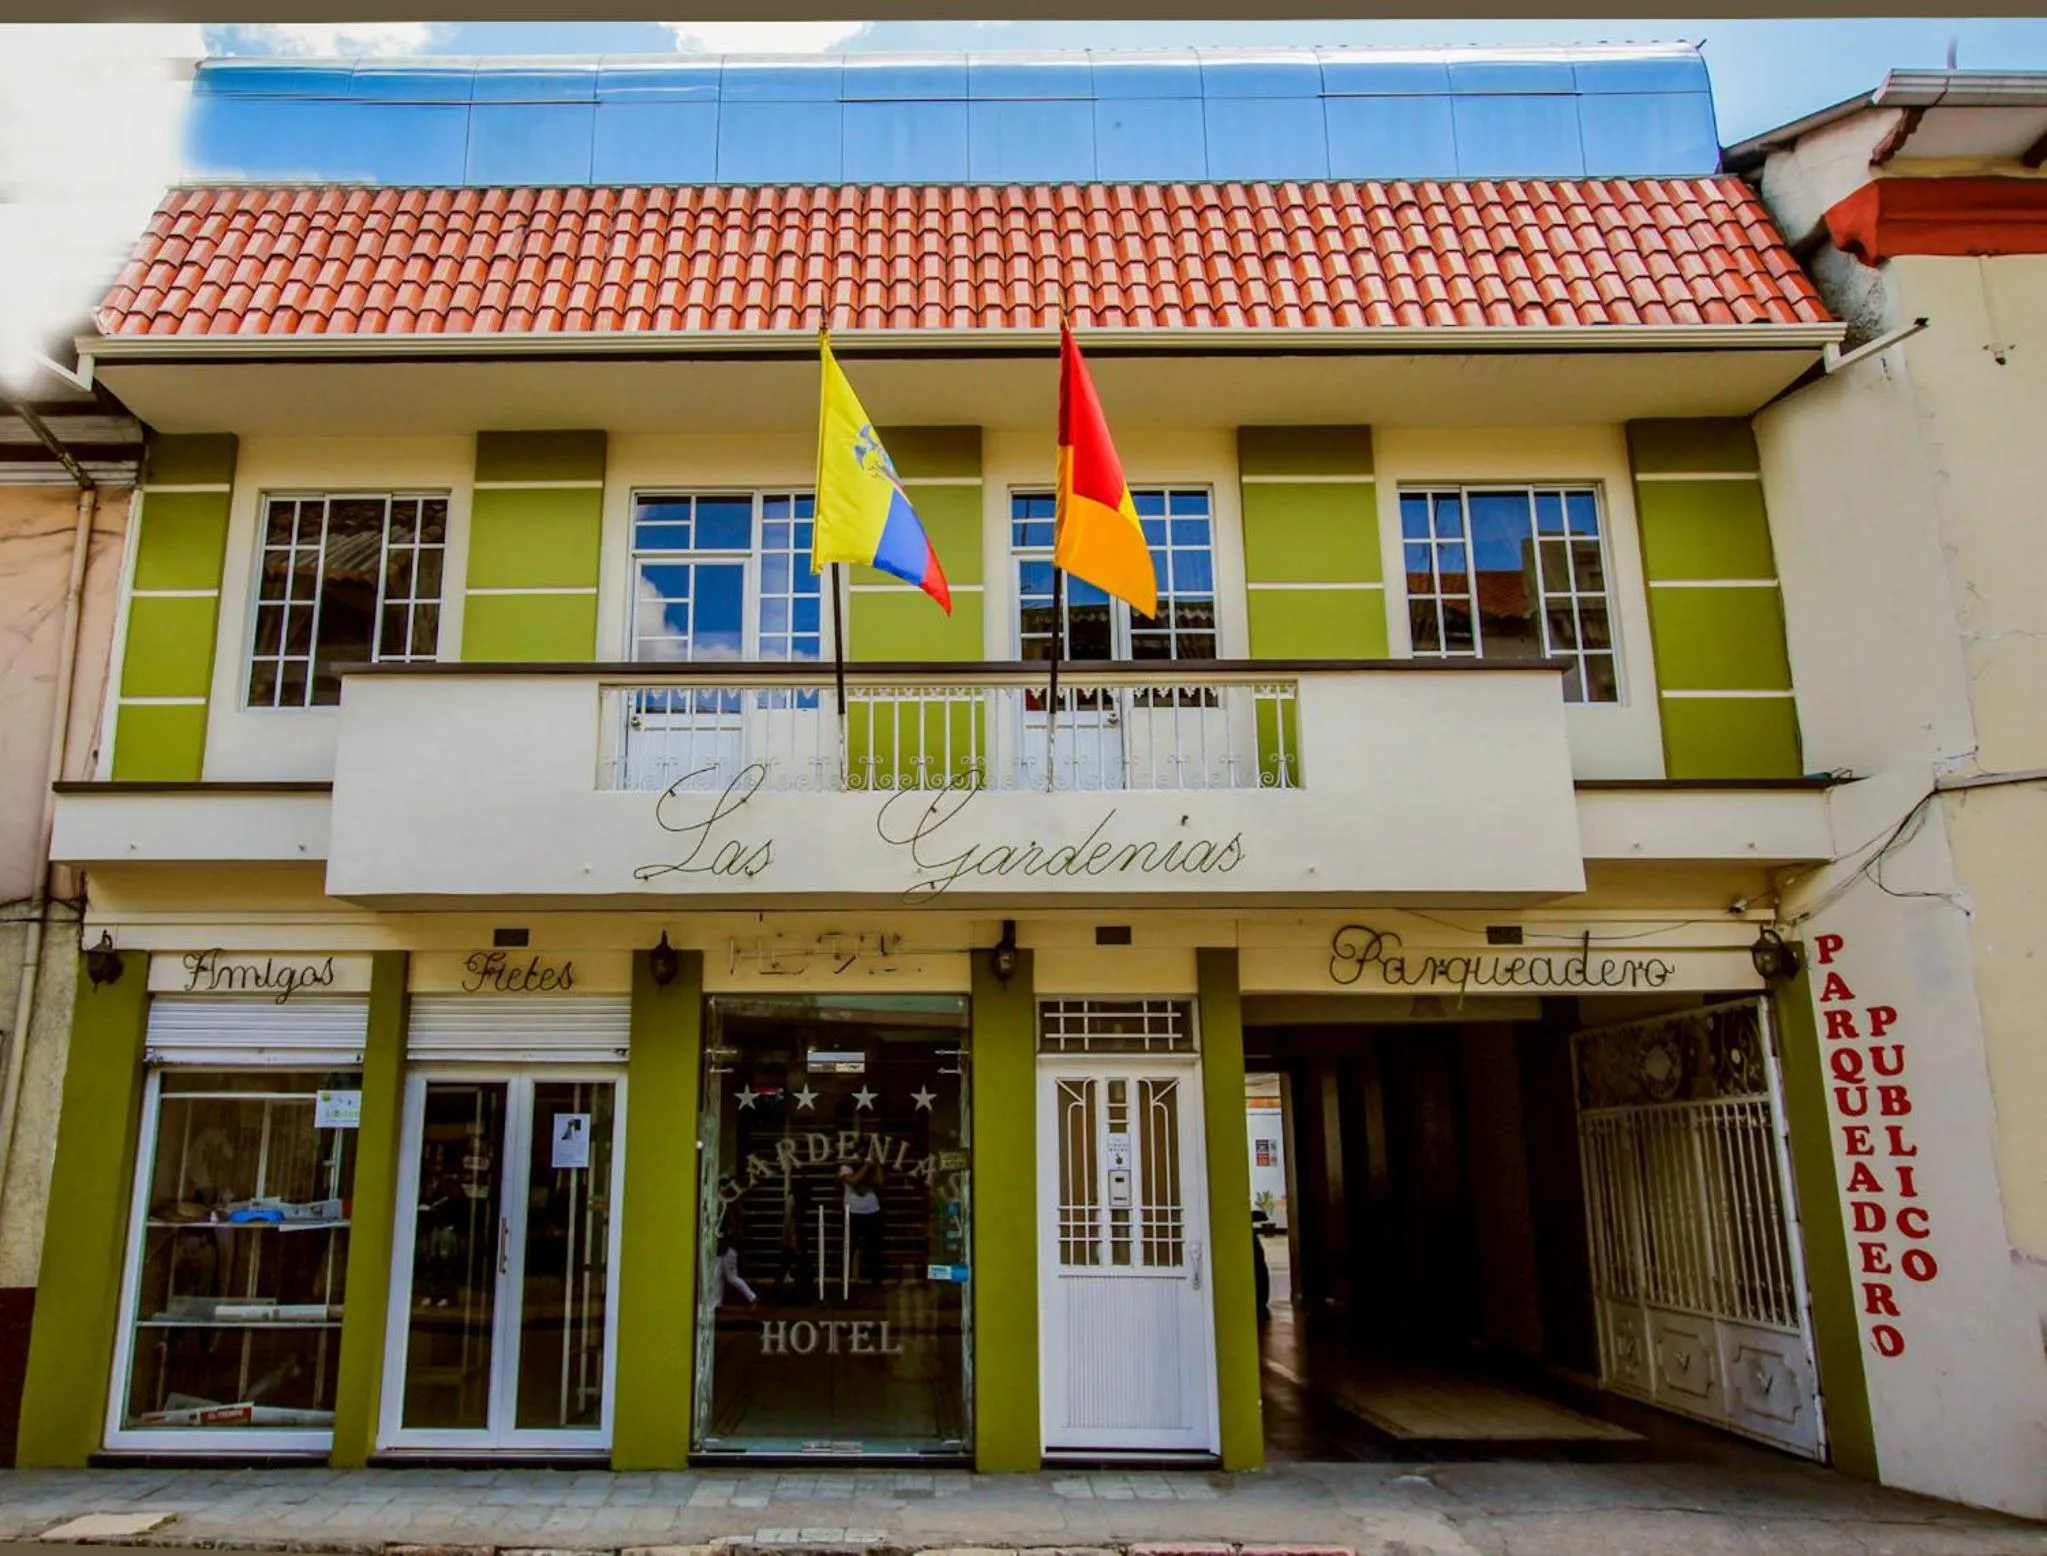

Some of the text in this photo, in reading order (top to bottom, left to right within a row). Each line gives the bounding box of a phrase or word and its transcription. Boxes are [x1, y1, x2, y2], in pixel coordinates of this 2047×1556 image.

[633, 763, 1247, 905] Las Gardenias
[183, 947, 334, 1005] Amigos
[1329, 923, 1675, 996] Parqueadero
[1813, 933, 1906, 1358] PARQUEADERO
[1865, 1004, 1939, 1282] PUBLICO
[759, 1319, 905, 1355] HOTEL
